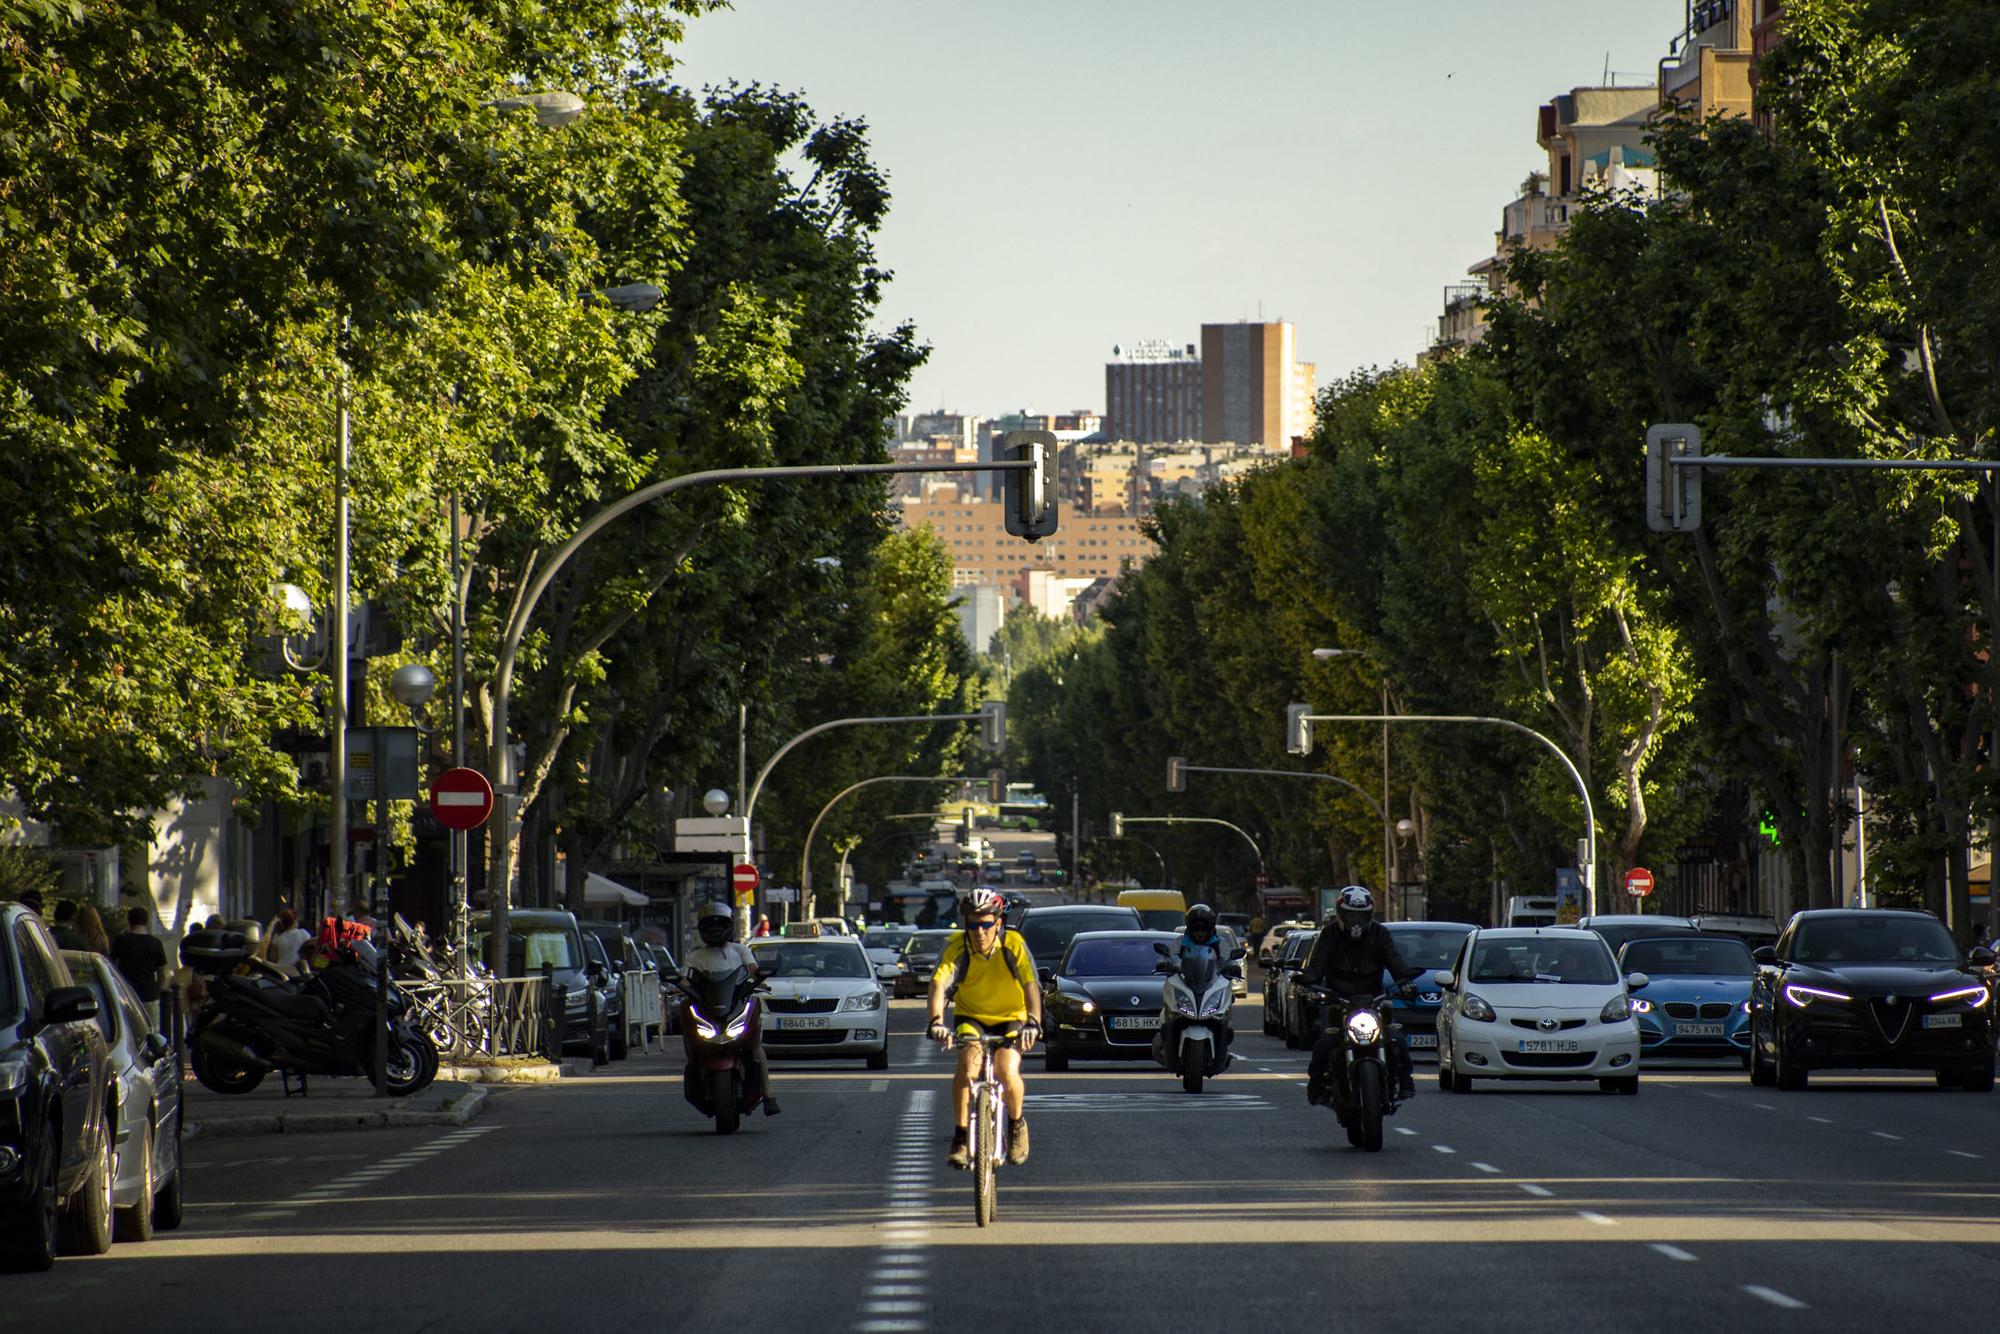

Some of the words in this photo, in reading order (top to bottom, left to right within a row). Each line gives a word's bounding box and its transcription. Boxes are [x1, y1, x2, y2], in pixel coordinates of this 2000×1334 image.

[1116, 1018, 1139, 1027] 6815
[1678, 1025, 1702, 1034] 9475
[1413, 1036, 1436, 1046] 2248
[1526, 1041, 1552, 1051] 5781
[1557, 1041, 1578, 1051] HJB
